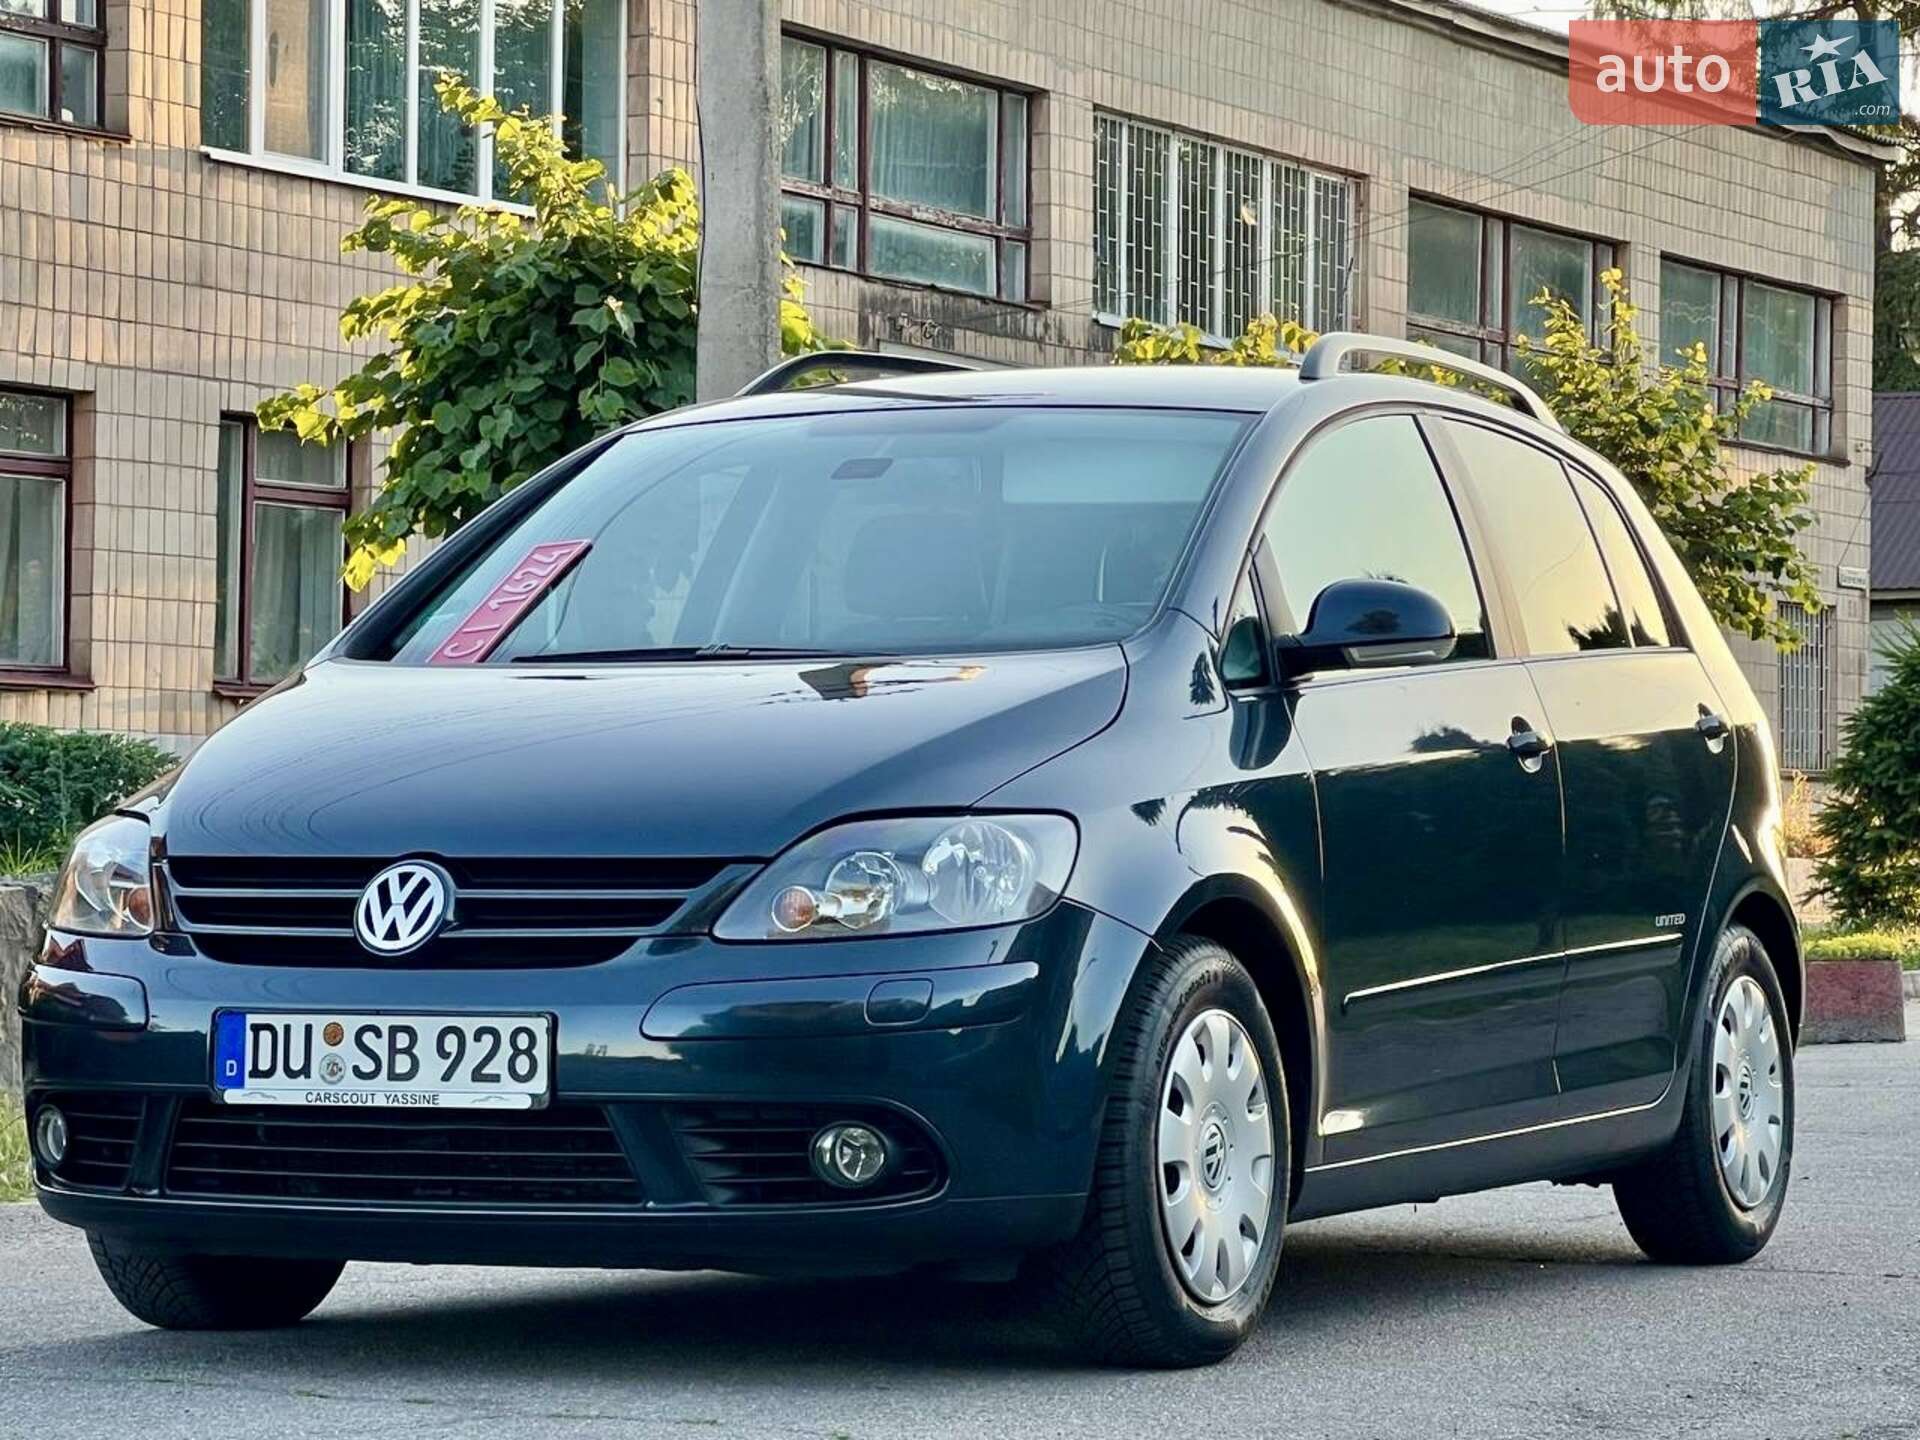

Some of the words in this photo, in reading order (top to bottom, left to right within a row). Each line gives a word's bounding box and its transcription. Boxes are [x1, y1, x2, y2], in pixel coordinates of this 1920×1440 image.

[487, 549, 574, 611] 1624
[1655, 913, 1686, 927] UNITED
[249, 1023, 313, 1079] DU
[352, 1024, 420, 1082] SB
[436, 1025, 539, 1083] 928
[225, 1060, 238, 1077] D
[304, 1091, 376, 1105] CARSCOUT
[384, 1092, 440, 1106] YASSINE
